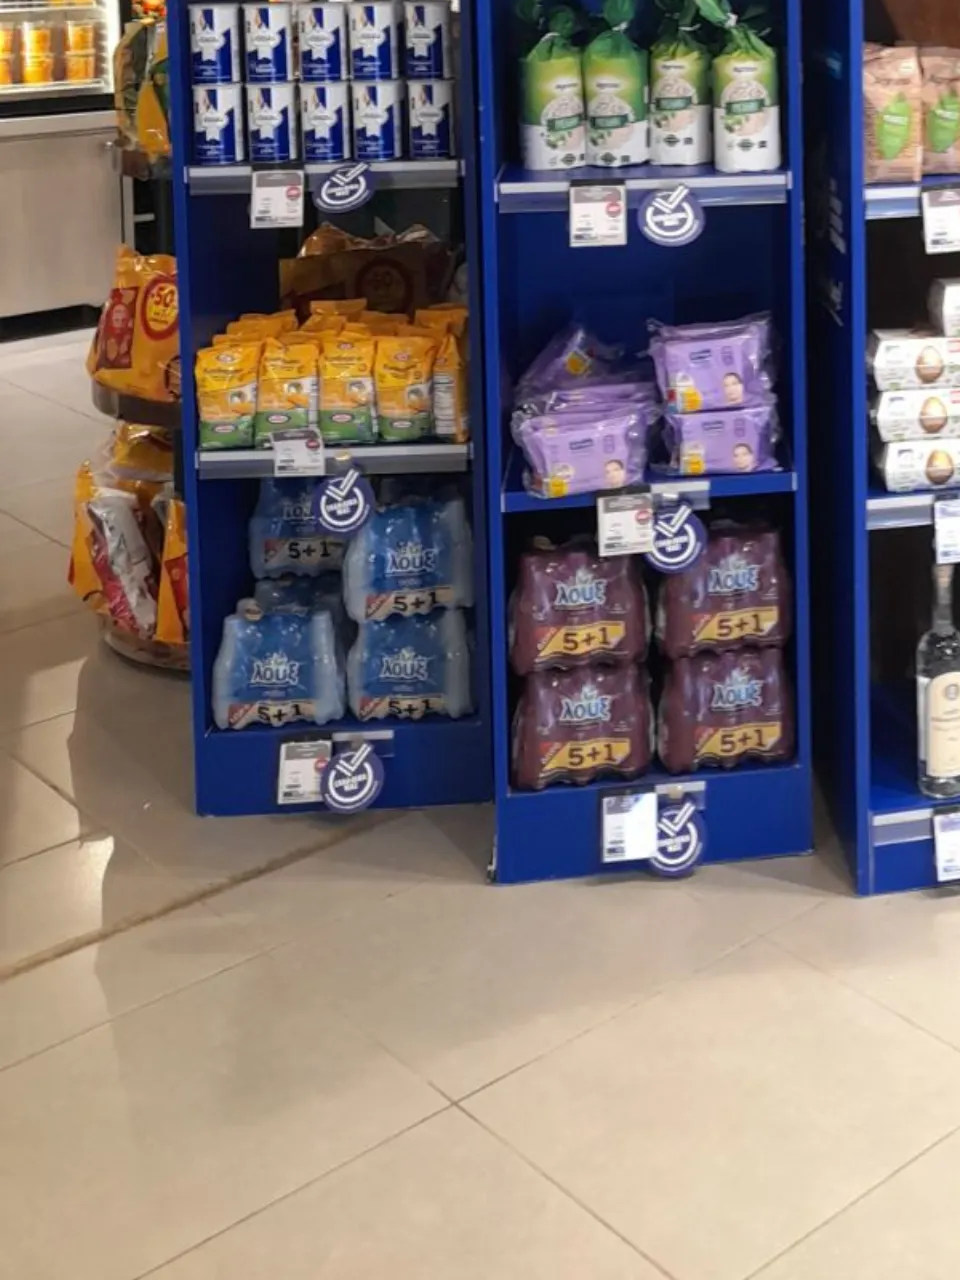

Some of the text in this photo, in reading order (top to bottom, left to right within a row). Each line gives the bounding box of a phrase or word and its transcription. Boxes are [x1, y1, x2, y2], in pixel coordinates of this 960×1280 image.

[288, 541, 331, 560] 5+1
[392, 591, 436, 612] 5+1
[716, 613, 764, 637] 5+1
[563, 627, 610, 651] 5+1
[257, 703, 301, 723] 5+1
[720, 728, 767, 753] 5+1
[568, 743, 616, 766] 5+1
